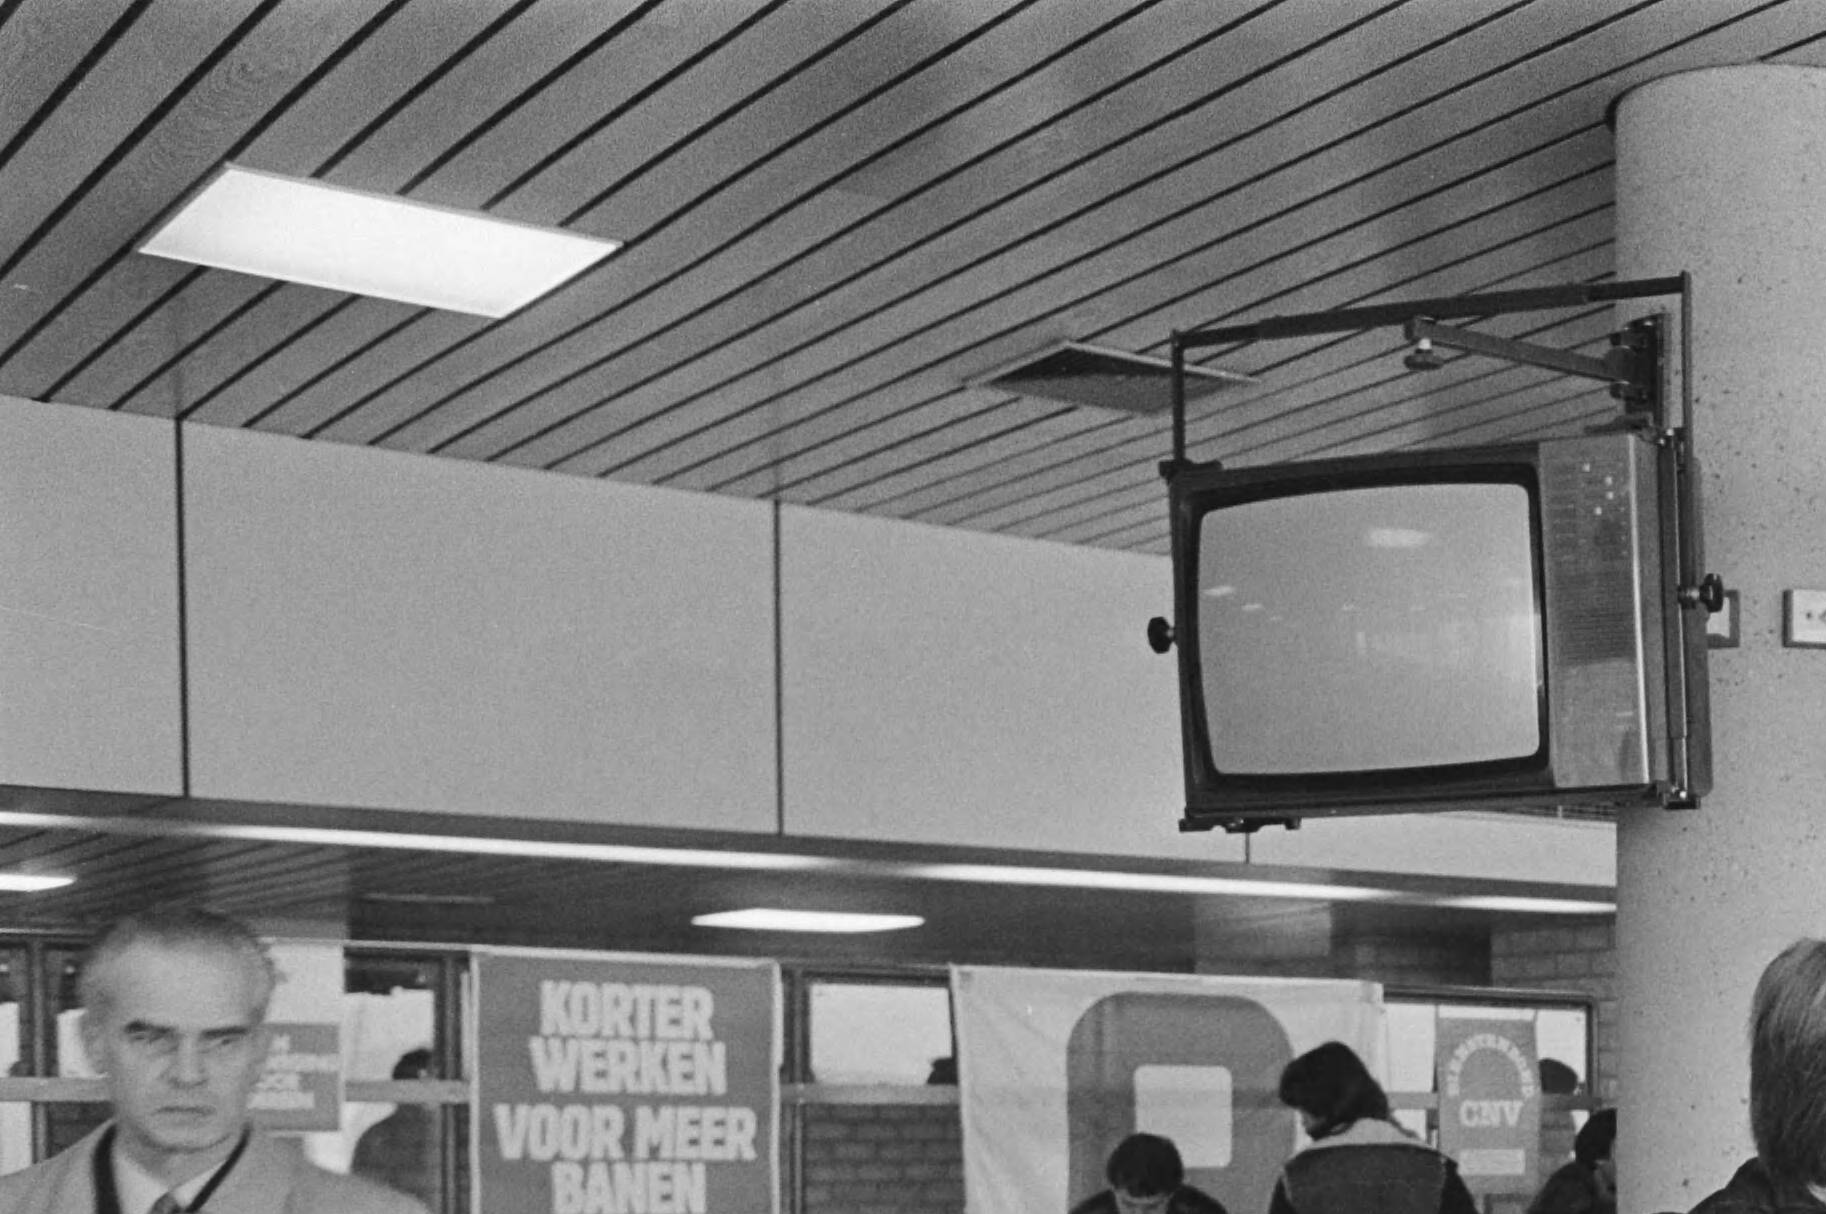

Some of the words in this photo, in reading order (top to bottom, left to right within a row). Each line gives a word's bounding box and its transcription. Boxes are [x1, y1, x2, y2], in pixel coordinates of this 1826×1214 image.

[540, 981, 714, 1039] KORTER
[531, 1038, 727, 1095] WERKEN
[493, 1103, 624, 1161] VOOR
[635, 1106, 757, 1161] MEER
[1461, 1100, 1524, 1127] CNV
